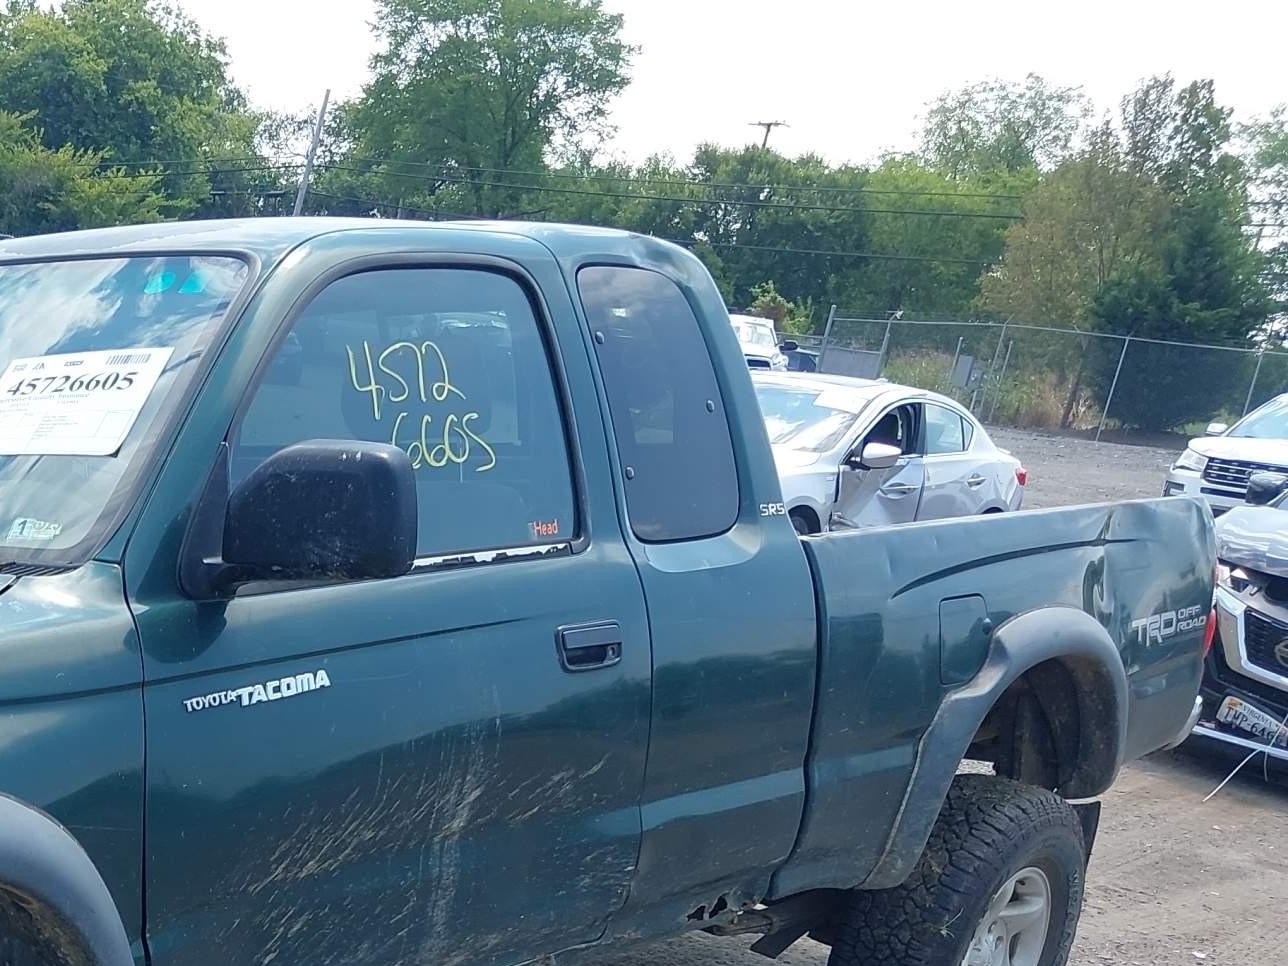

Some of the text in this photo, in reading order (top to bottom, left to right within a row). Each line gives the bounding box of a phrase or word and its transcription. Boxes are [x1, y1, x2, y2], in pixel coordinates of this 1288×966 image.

[7, 371, 139, 396] 45726605
[346, 340, 467, 420] 4572
[392, 412, 496, 472] 6605
[1130, 610, 1176, 647] TRD
[1177, 604, 1202, 619] OFF
[1177, 615, 1208, 632] ROAD
[183, 669, 331, 713] TOYOTA TACOMA
